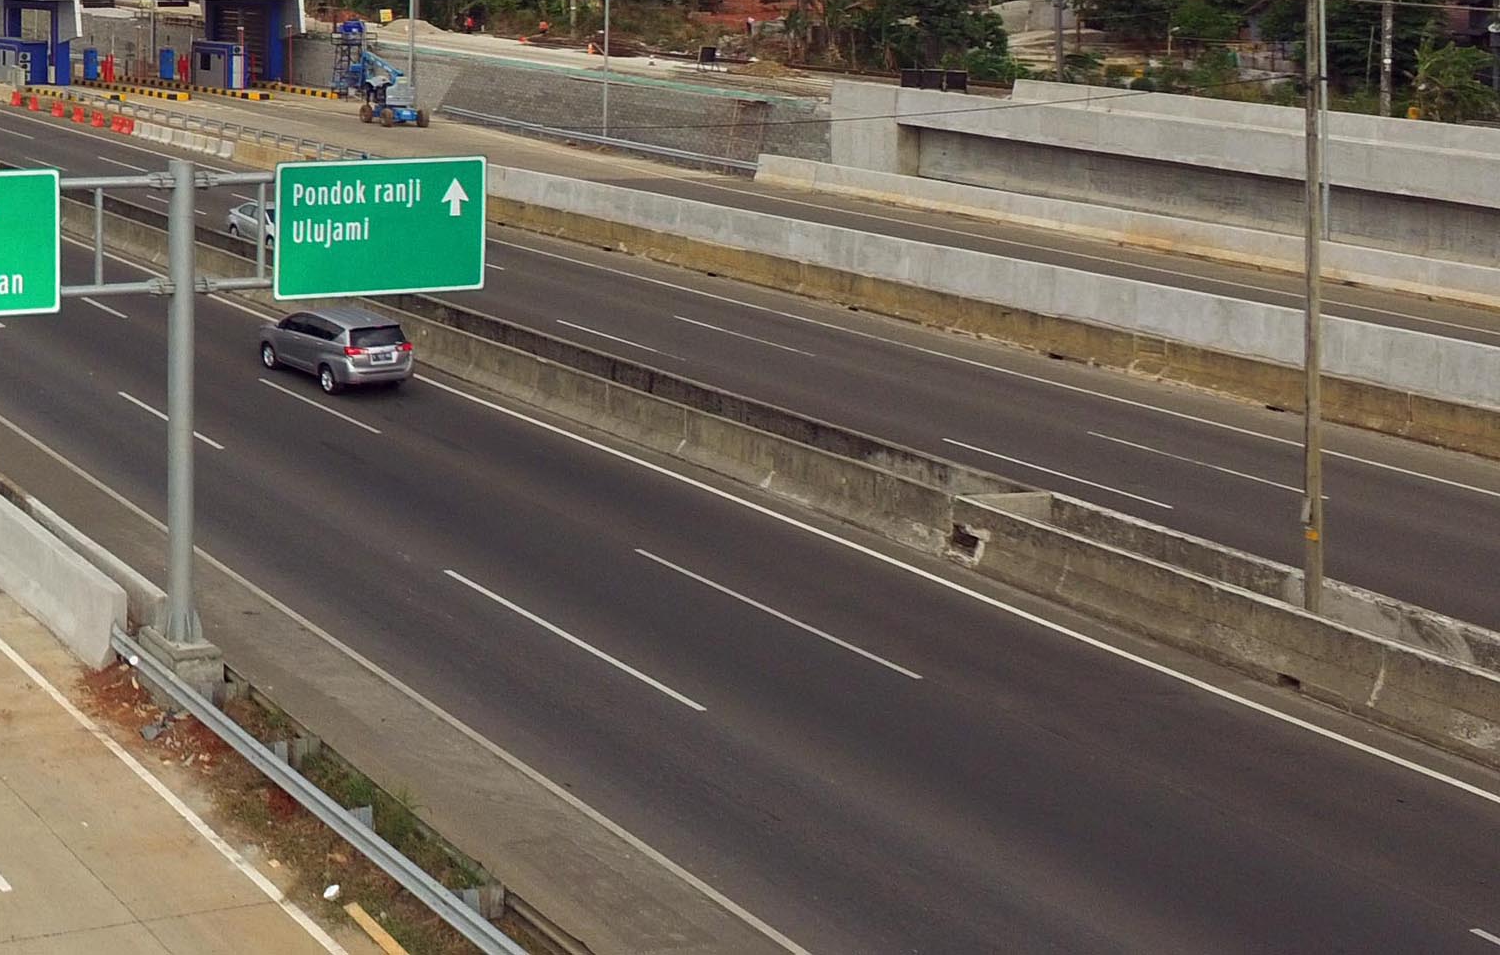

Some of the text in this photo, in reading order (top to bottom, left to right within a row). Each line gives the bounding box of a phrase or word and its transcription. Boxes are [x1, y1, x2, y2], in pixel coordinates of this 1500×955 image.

[292, 178, 422, 208] Pondok ranji
[292, 216, 370, 249] Ulujami
